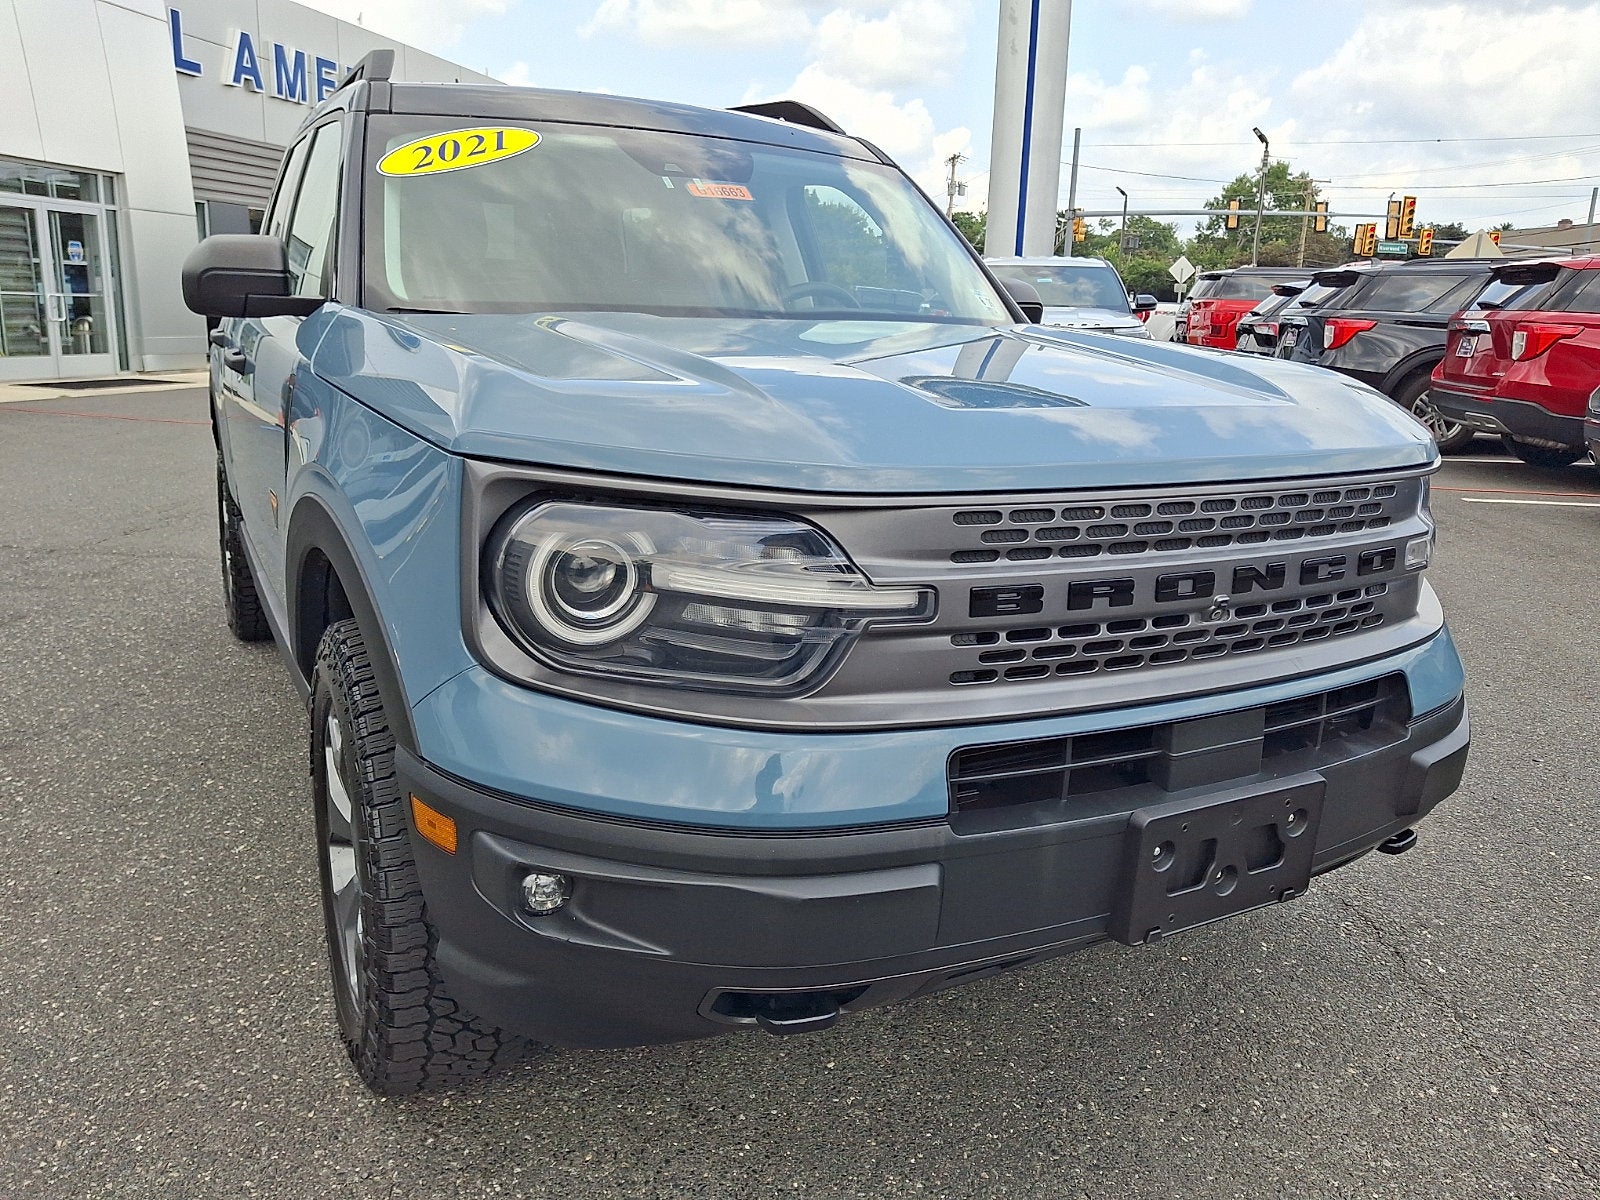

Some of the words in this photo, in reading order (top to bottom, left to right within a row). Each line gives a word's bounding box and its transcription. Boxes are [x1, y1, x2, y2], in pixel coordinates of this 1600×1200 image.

[230, 30, 352, 104] AME
[412, 130, 509, 170] 2021
[969, 547, 1397, 618] BRONCO
